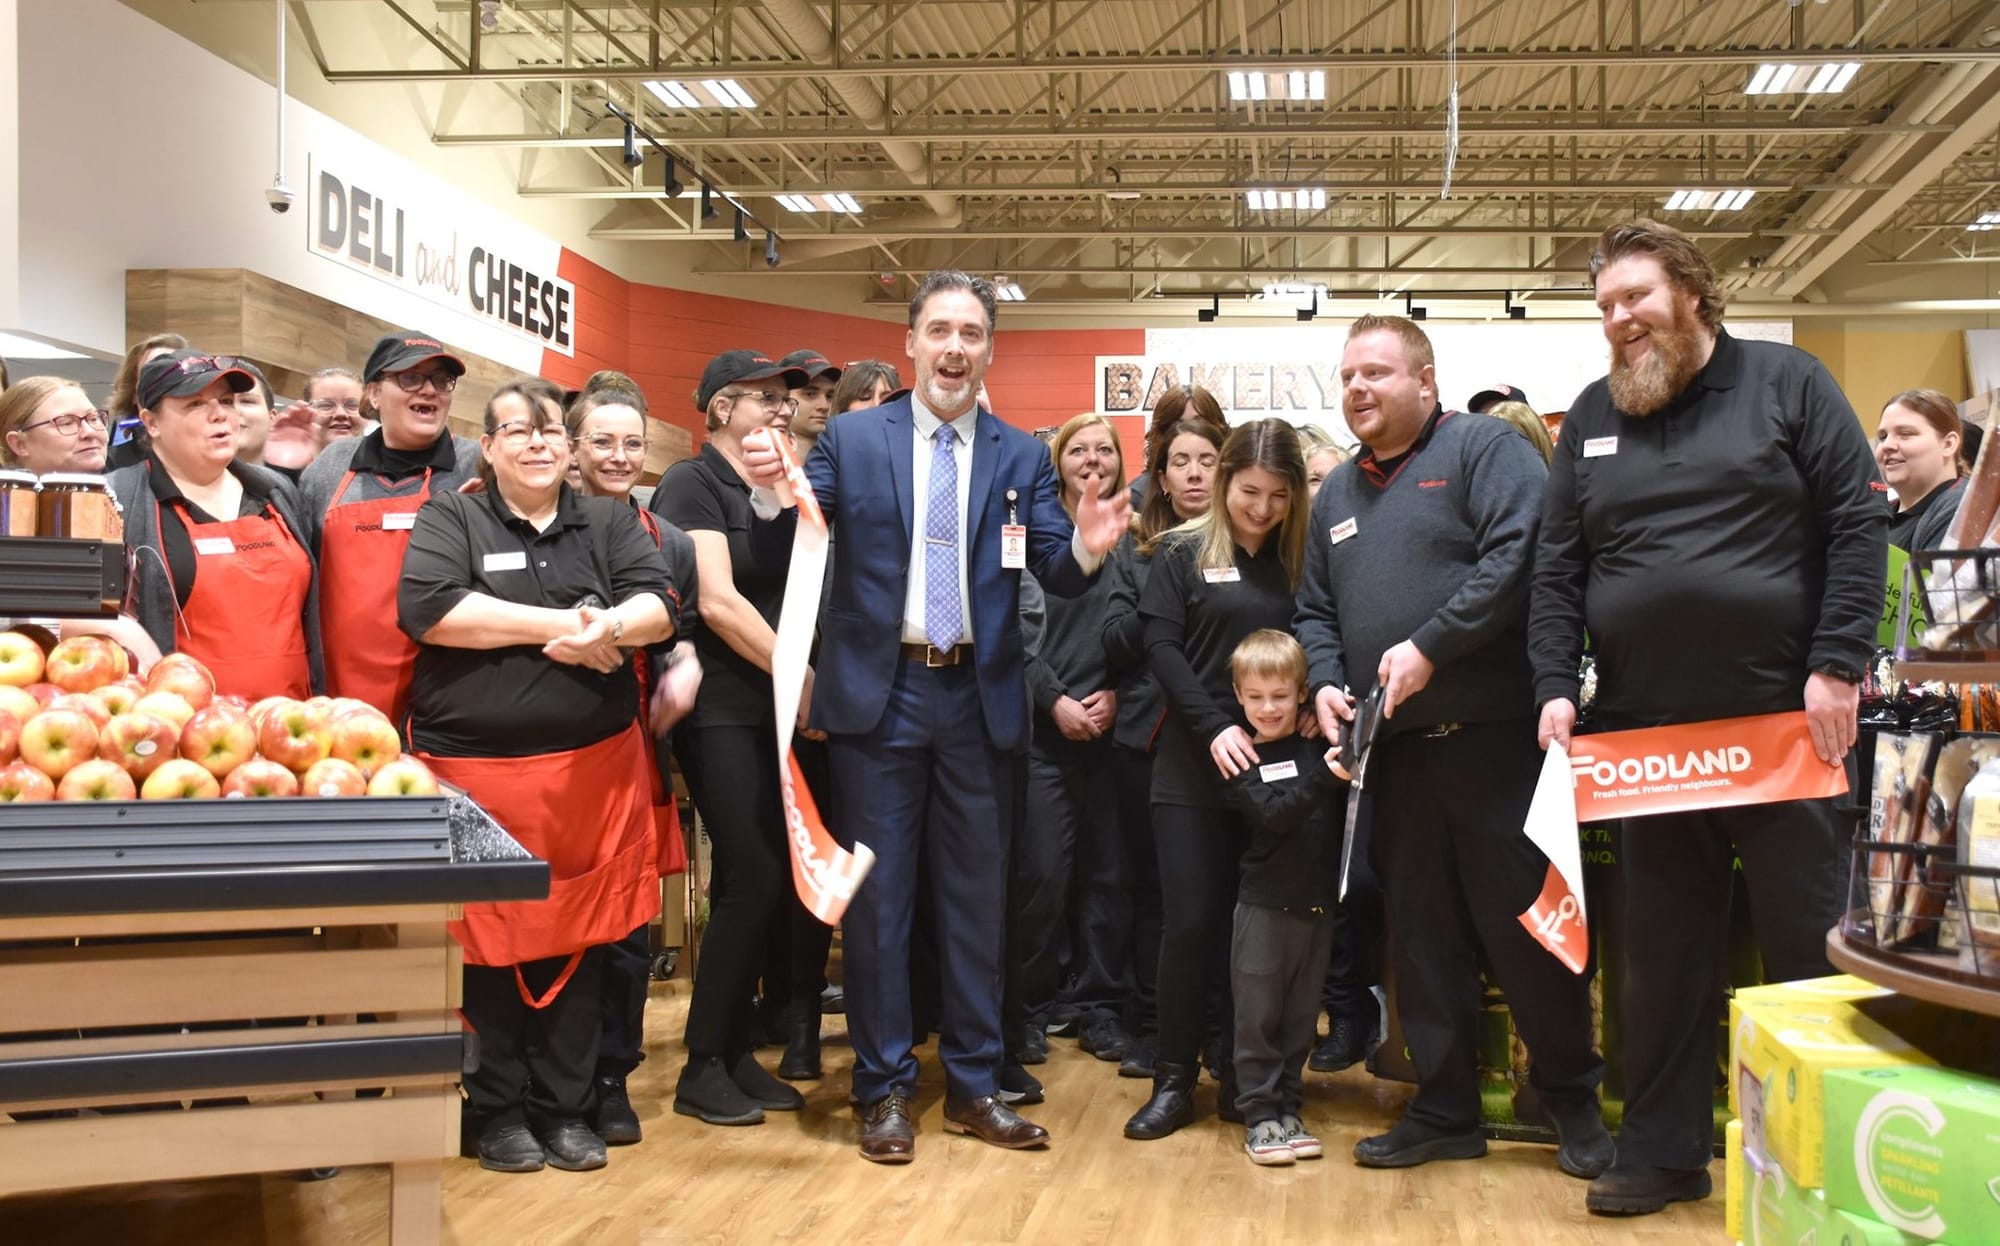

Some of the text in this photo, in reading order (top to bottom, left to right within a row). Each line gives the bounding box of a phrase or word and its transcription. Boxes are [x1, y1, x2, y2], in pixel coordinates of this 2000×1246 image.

[318, 170, 569, 348] DELI and CHEESE
[1105, 362, 1341, 412] BAKERY
[1569, 746, 1751, 788] FOODLAND
[1593, 778, 1732, 800] Fresh food. Friendly neighbours.
